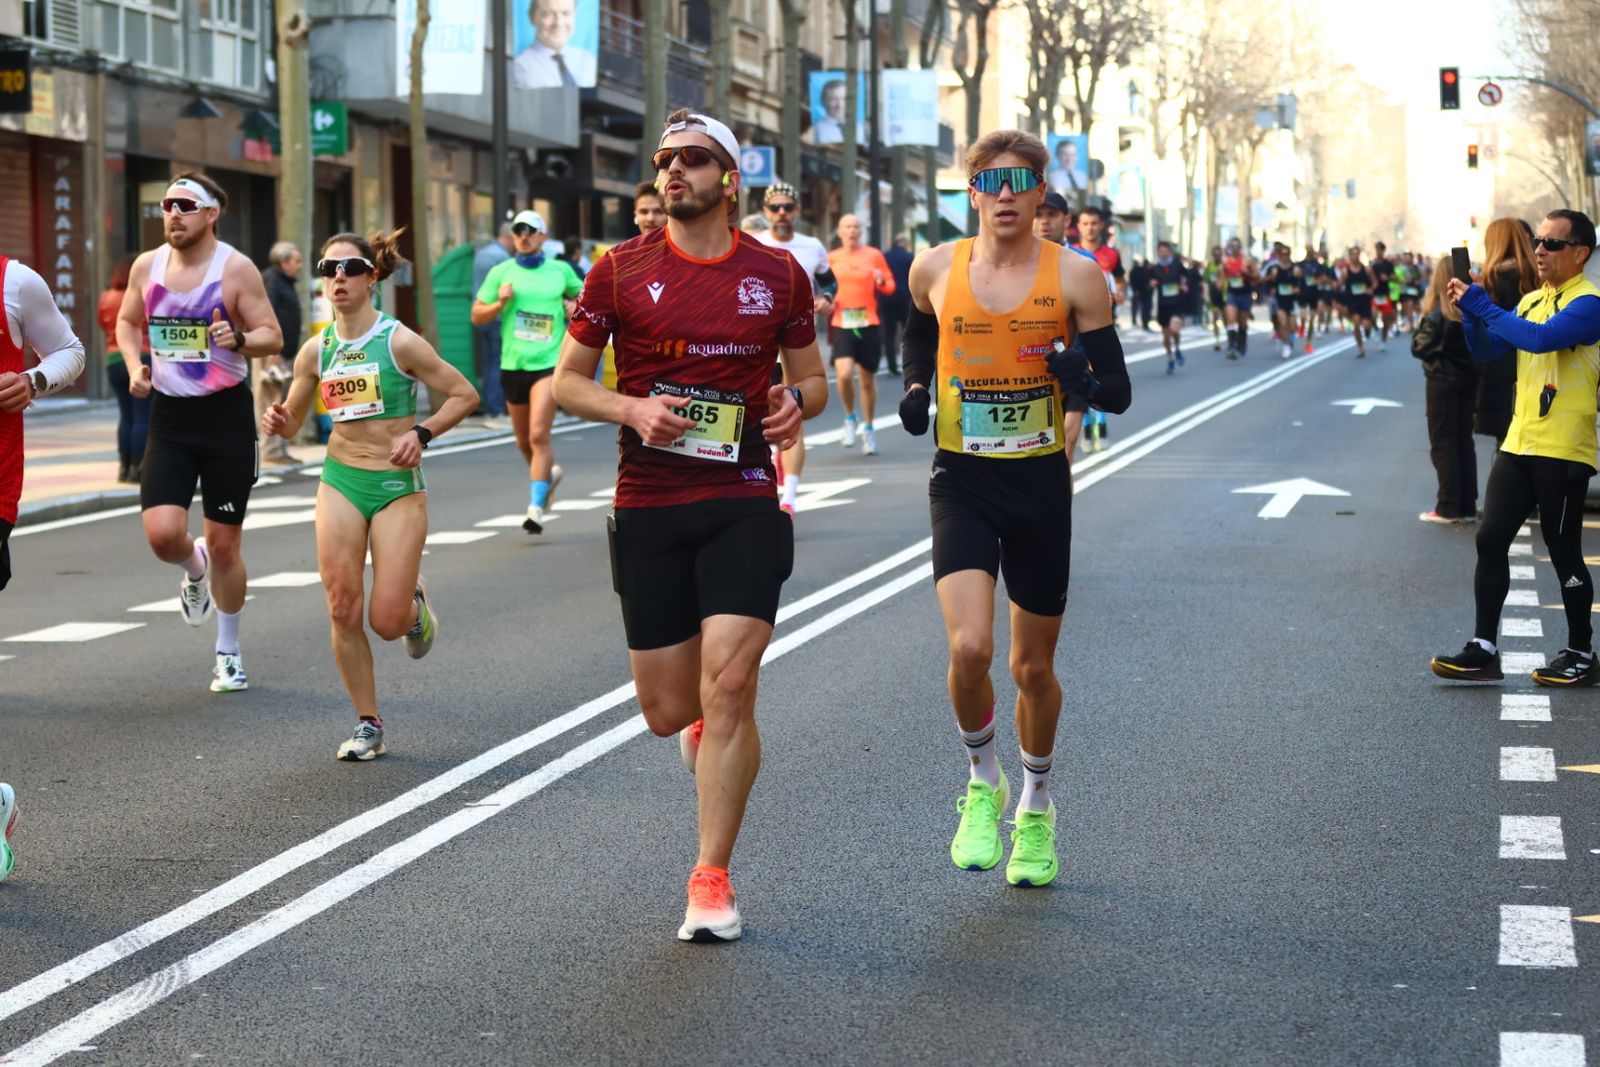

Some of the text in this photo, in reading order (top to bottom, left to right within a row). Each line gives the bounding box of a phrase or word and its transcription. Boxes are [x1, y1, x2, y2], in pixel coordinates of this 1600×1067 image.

[160, 328, 198, 340] 1504
[688, 342, 761, 357] aquaducto
[328, 378, 367, 398] 2309
[964, 378, 1010, 387] ESCUELA
[988, 405, 1030, 423] 127
